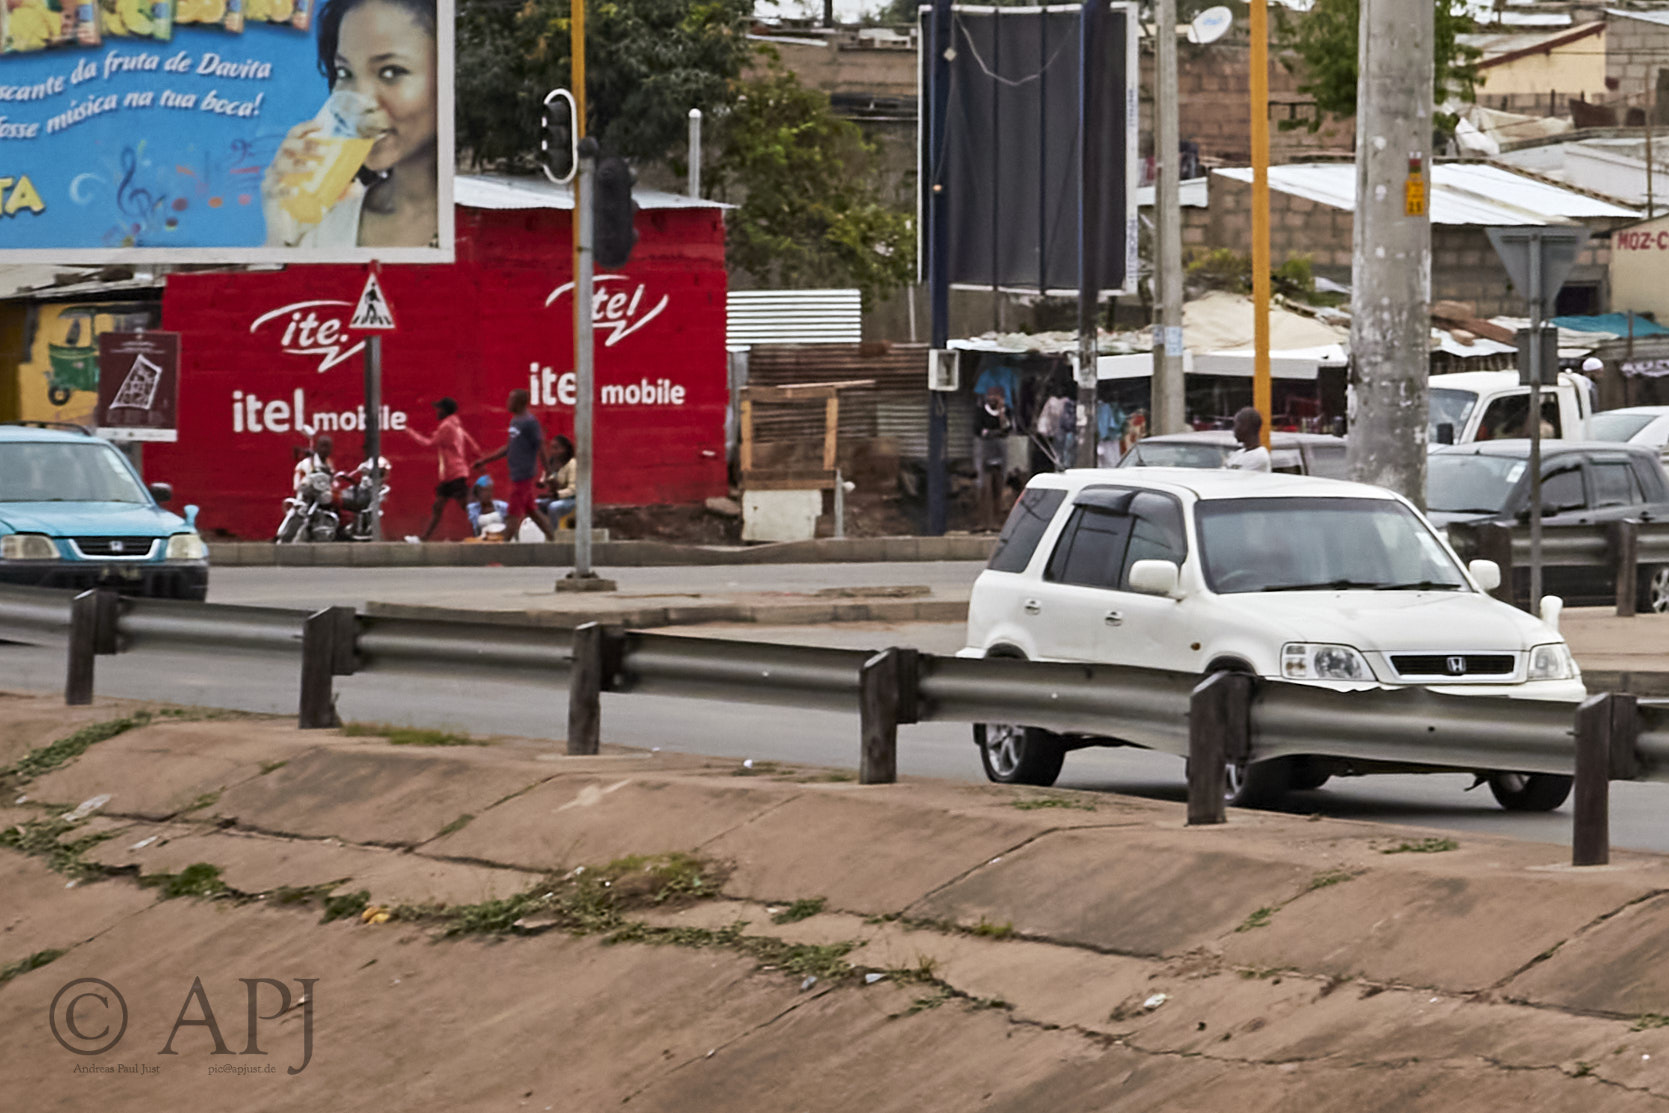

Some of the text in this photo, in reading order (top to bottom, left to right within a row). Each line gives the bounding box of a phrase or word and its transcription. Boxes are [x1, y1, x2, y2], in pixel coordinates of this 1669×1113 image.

[71, 58, 97, 85] da
[104, 50, 161, 79] fruta
[164, 51, 192, 72] de
[196, 53, 272, 79] Davita
[123, 91, 154, 107] na
[160, 89, 197, 108] tua
[201, 89, 264, 117] boca!
[592, 284, 645, 319] tel
[281, 311, 349, 347] ite
[530, 362, 685, 405] ite mobile
[233, 388, 304, 432] itel
